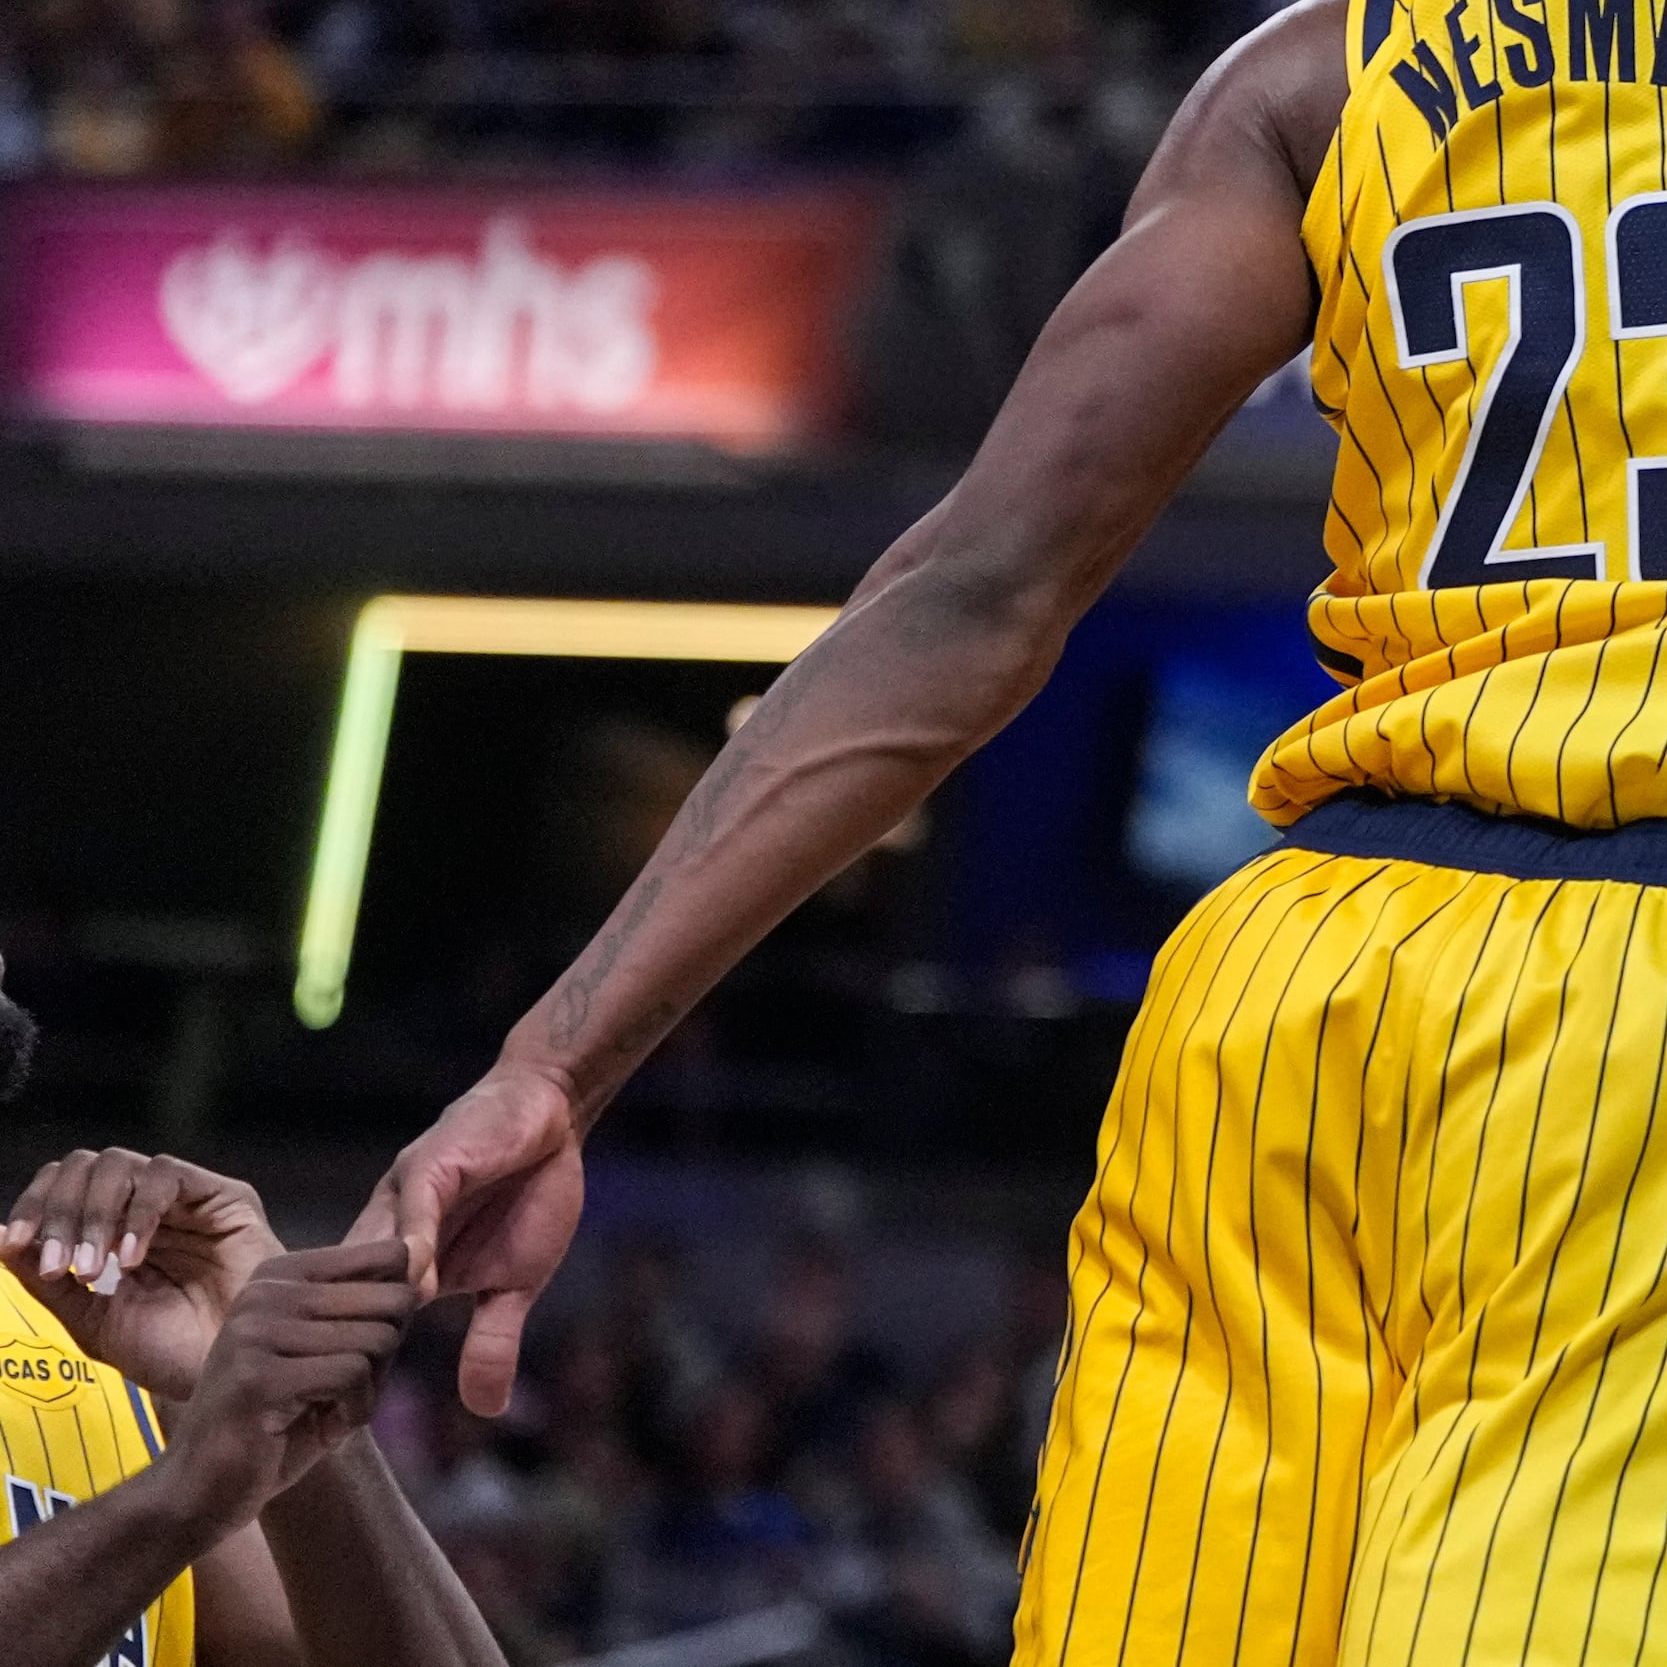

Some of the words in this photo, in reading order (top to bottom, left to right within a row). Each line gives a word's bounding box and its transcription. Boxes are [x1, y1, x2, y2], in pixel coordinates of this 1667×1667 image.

[337, 213, 654, 409] mhs
[0, 1358, 50, 1381] CAS
[59, 1359, 95, 1383] OIL
